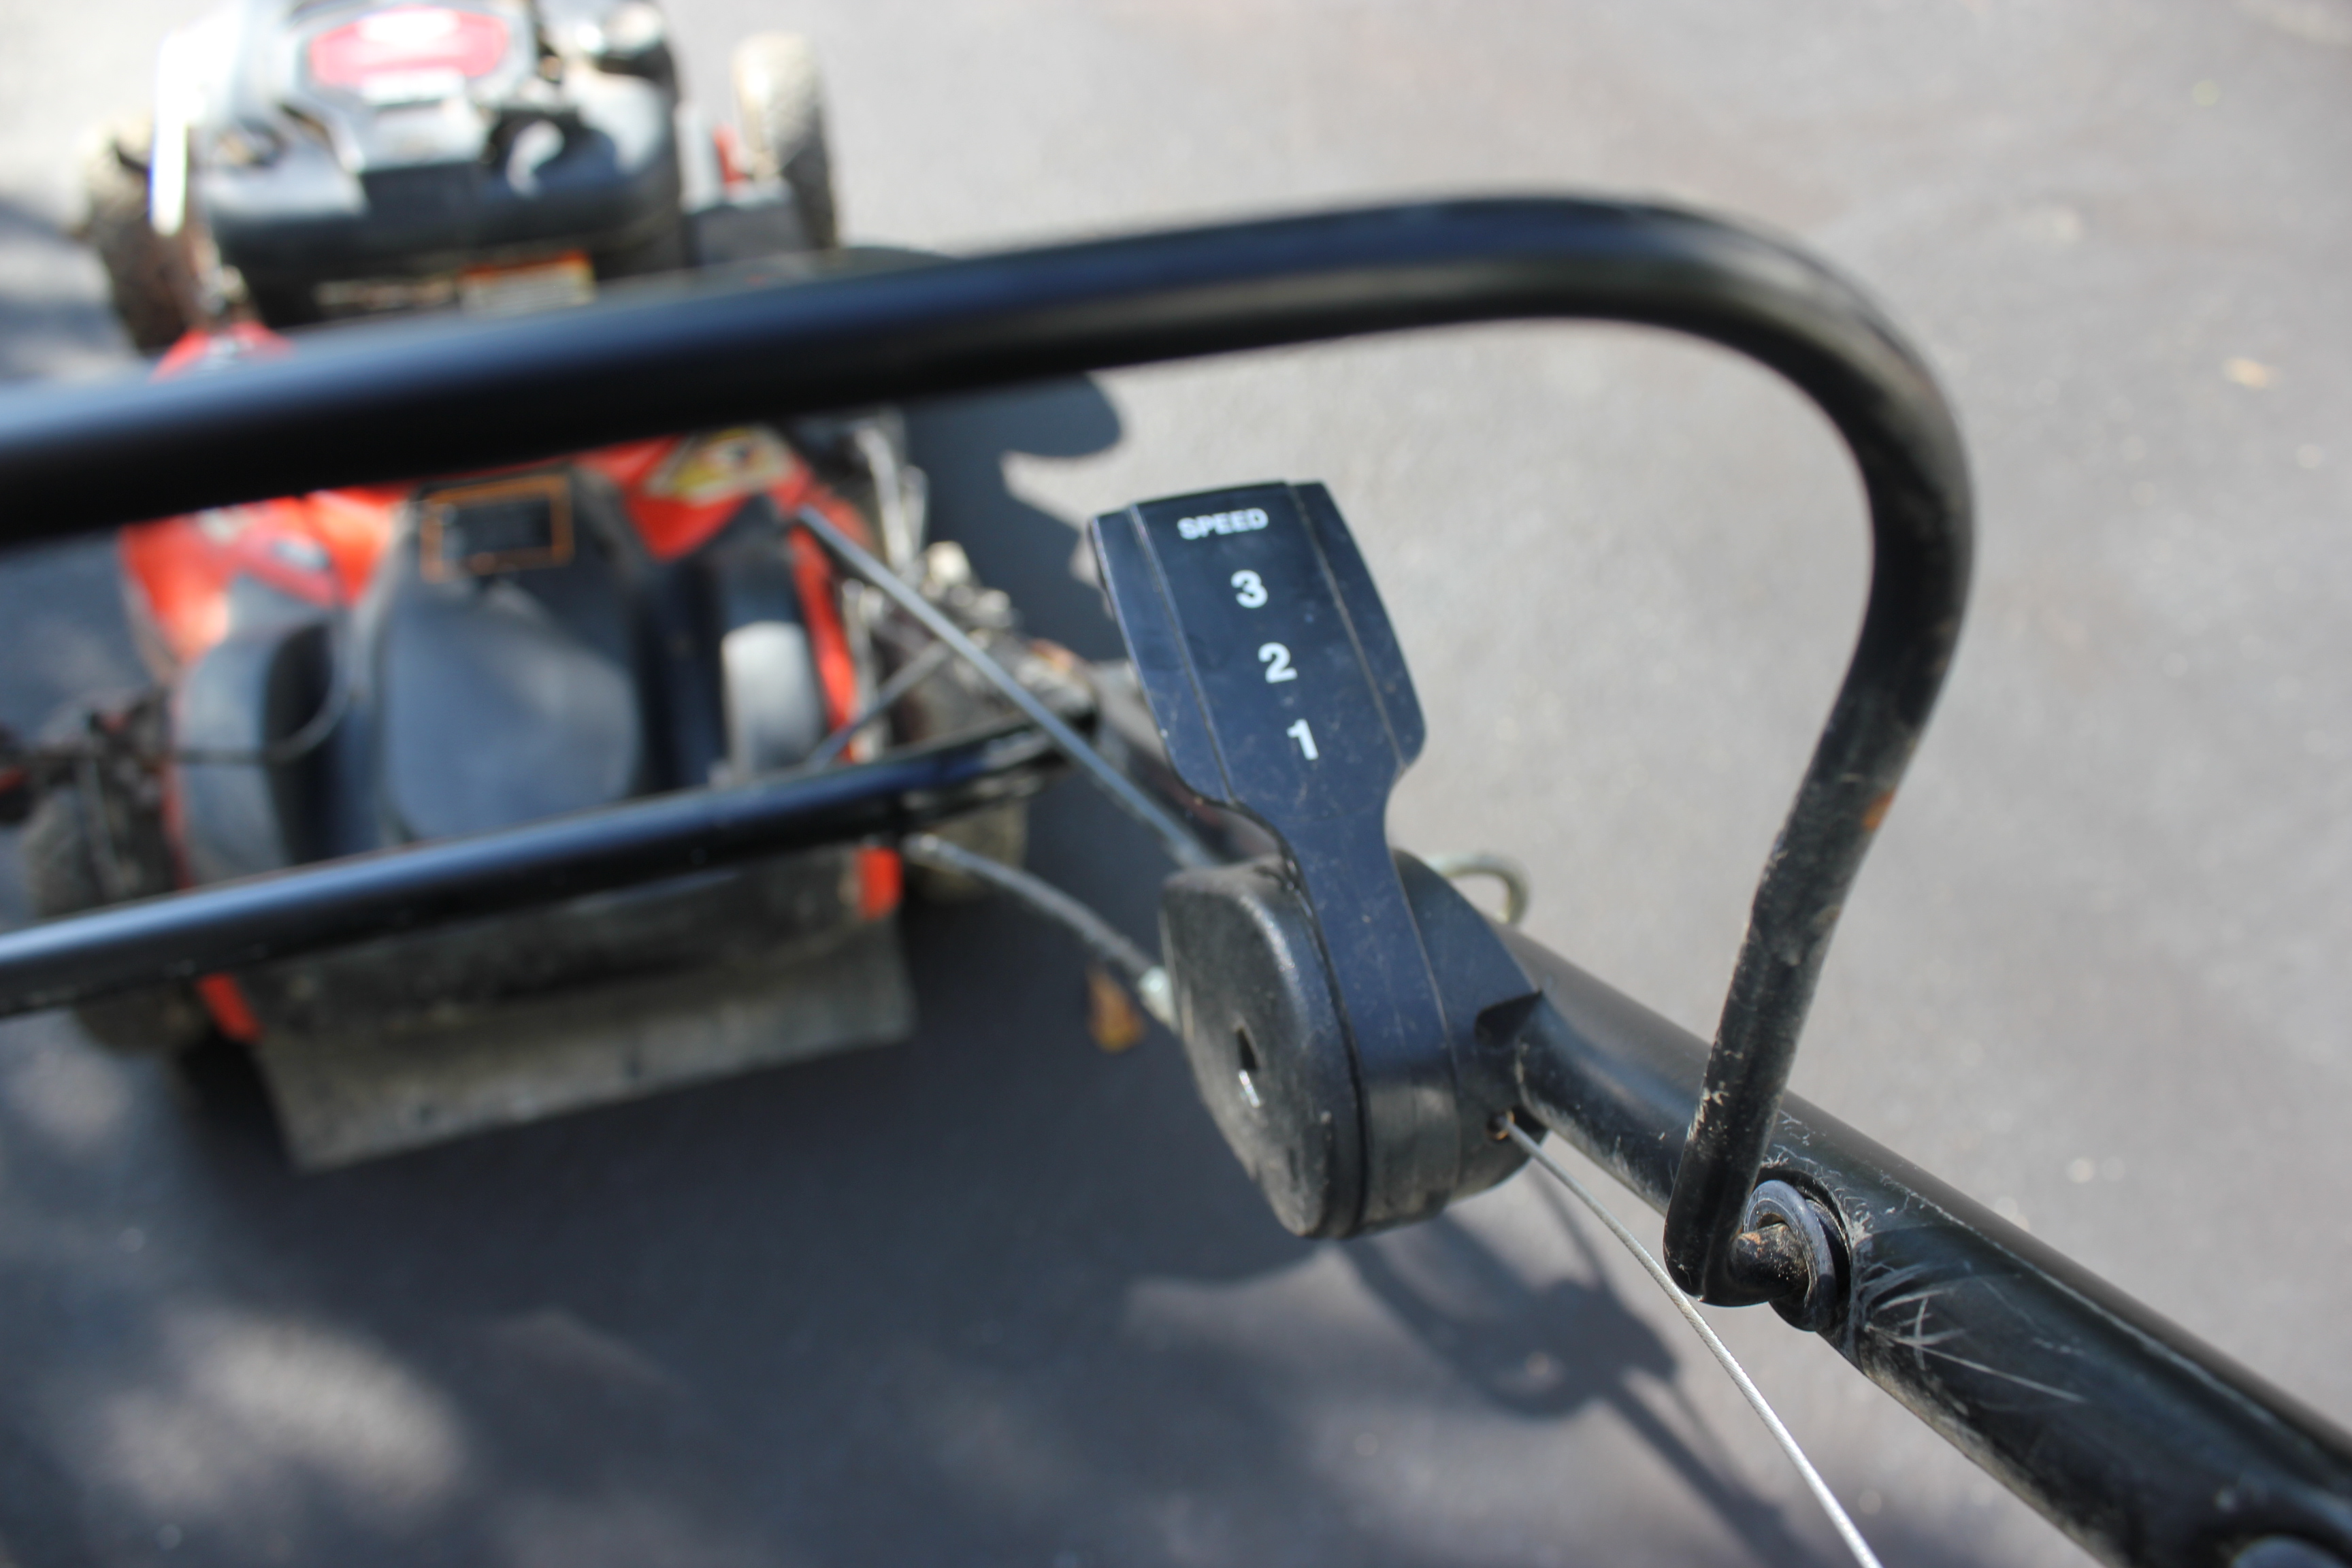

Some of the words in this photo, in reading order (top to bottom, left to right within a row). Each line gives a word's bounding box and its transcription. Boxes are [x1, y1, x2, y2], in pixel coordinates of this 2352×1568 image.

[1177, 508, 1269, 540] SPEED
[1231, 570, 1268, 608] 3
[1258, 642, 1297, 683] 2
[1287, 719, 1318, 760] 1
